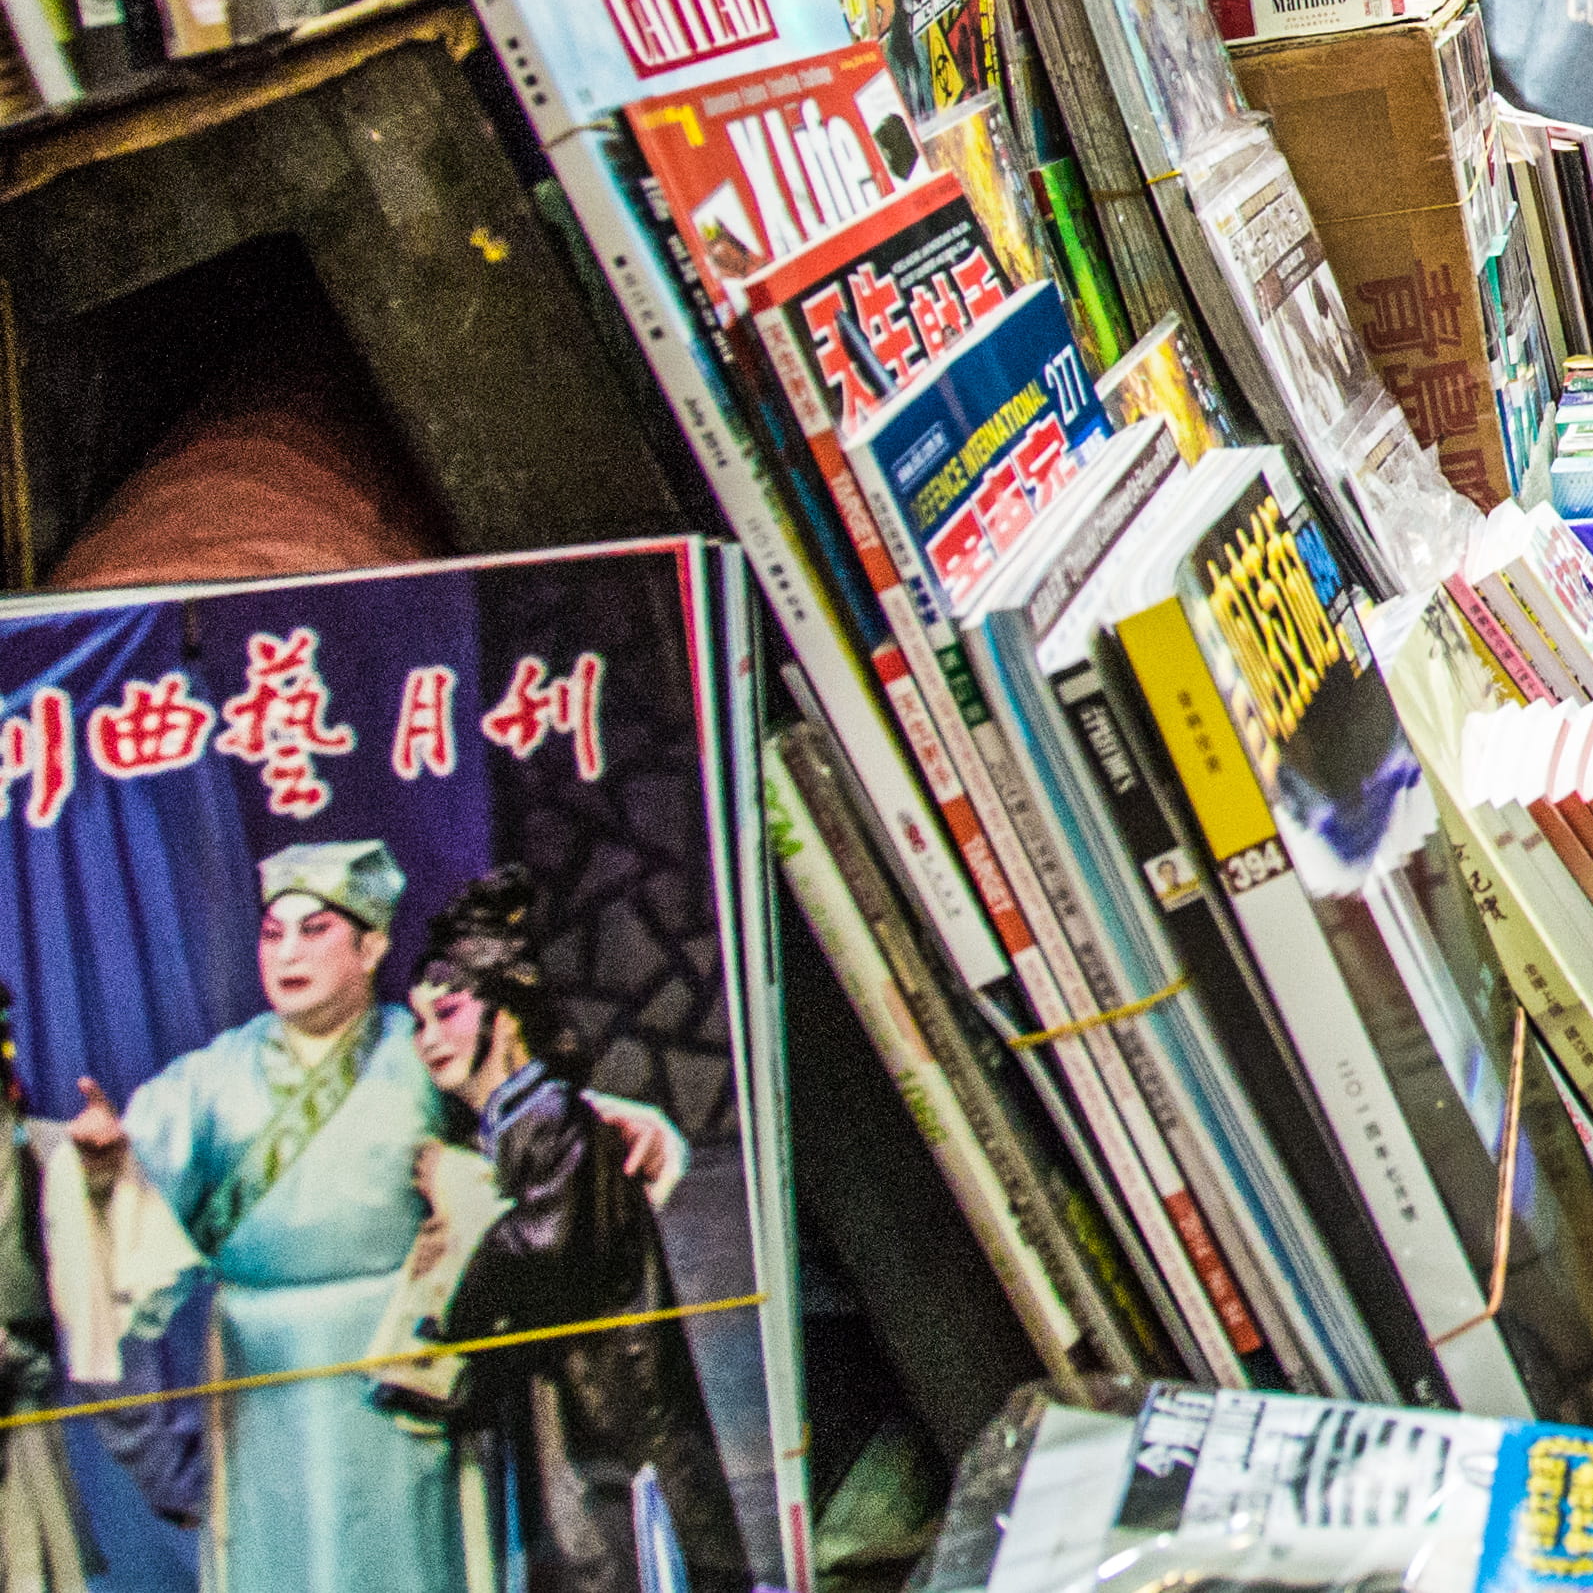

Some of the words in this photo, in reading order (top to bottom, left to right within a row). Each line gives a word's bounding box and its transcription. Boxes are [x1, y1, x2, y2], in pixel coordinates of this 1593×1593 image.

[958, 379, 1049, 481] INTERNATIONAL
[1045, 343, 1088, 426] 277
[1227, 850, 1287, 893] 394
